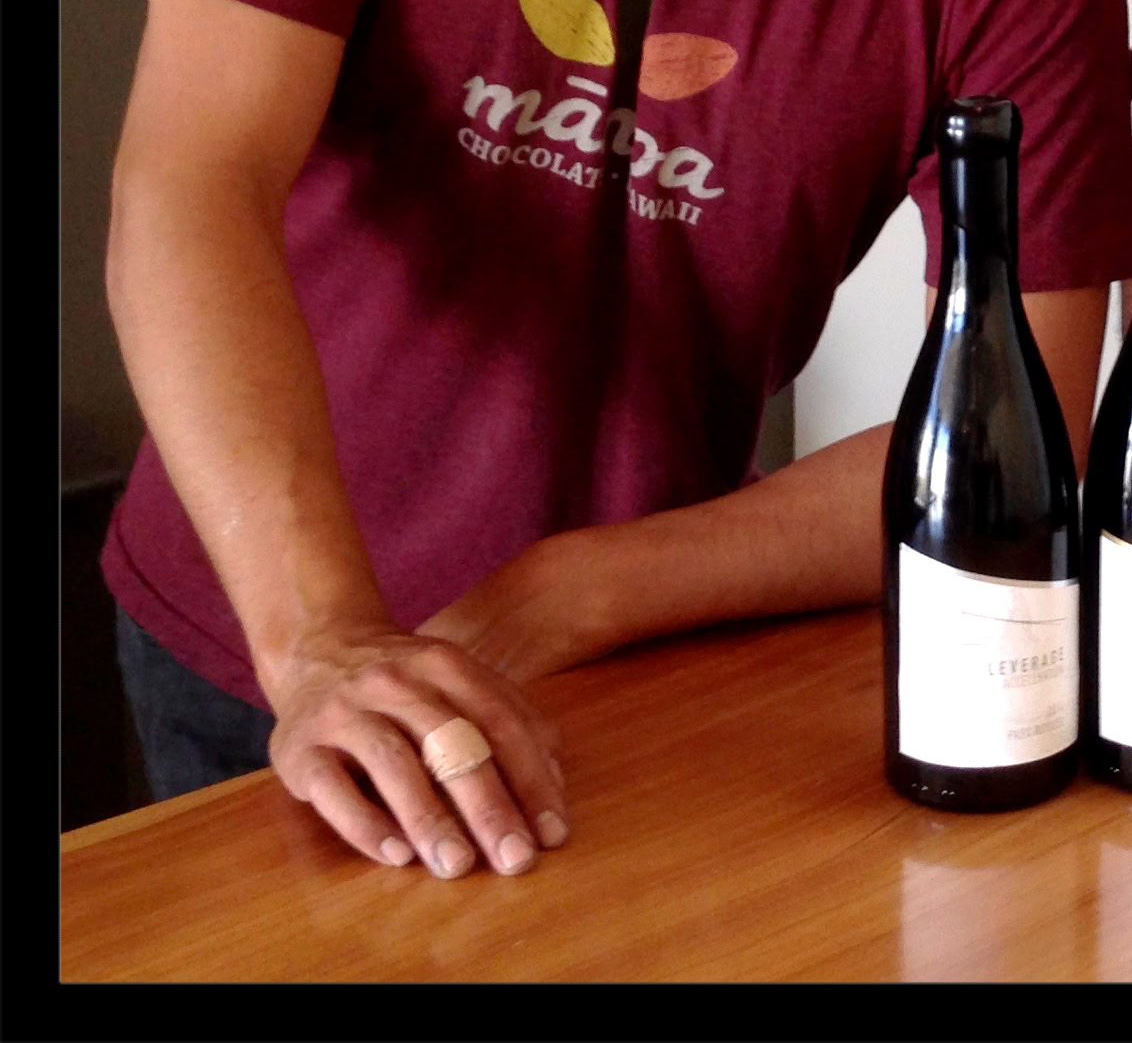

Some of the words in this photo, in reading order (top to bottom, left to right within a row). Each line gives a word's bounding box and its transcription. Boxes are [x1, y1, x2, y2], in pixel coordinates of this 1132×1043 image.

[457, 127, 604, 189] CHOCOLAT
[627, 180, 703, 225] AWAII
[987, 646, 1064, 676] LEVERAGE
